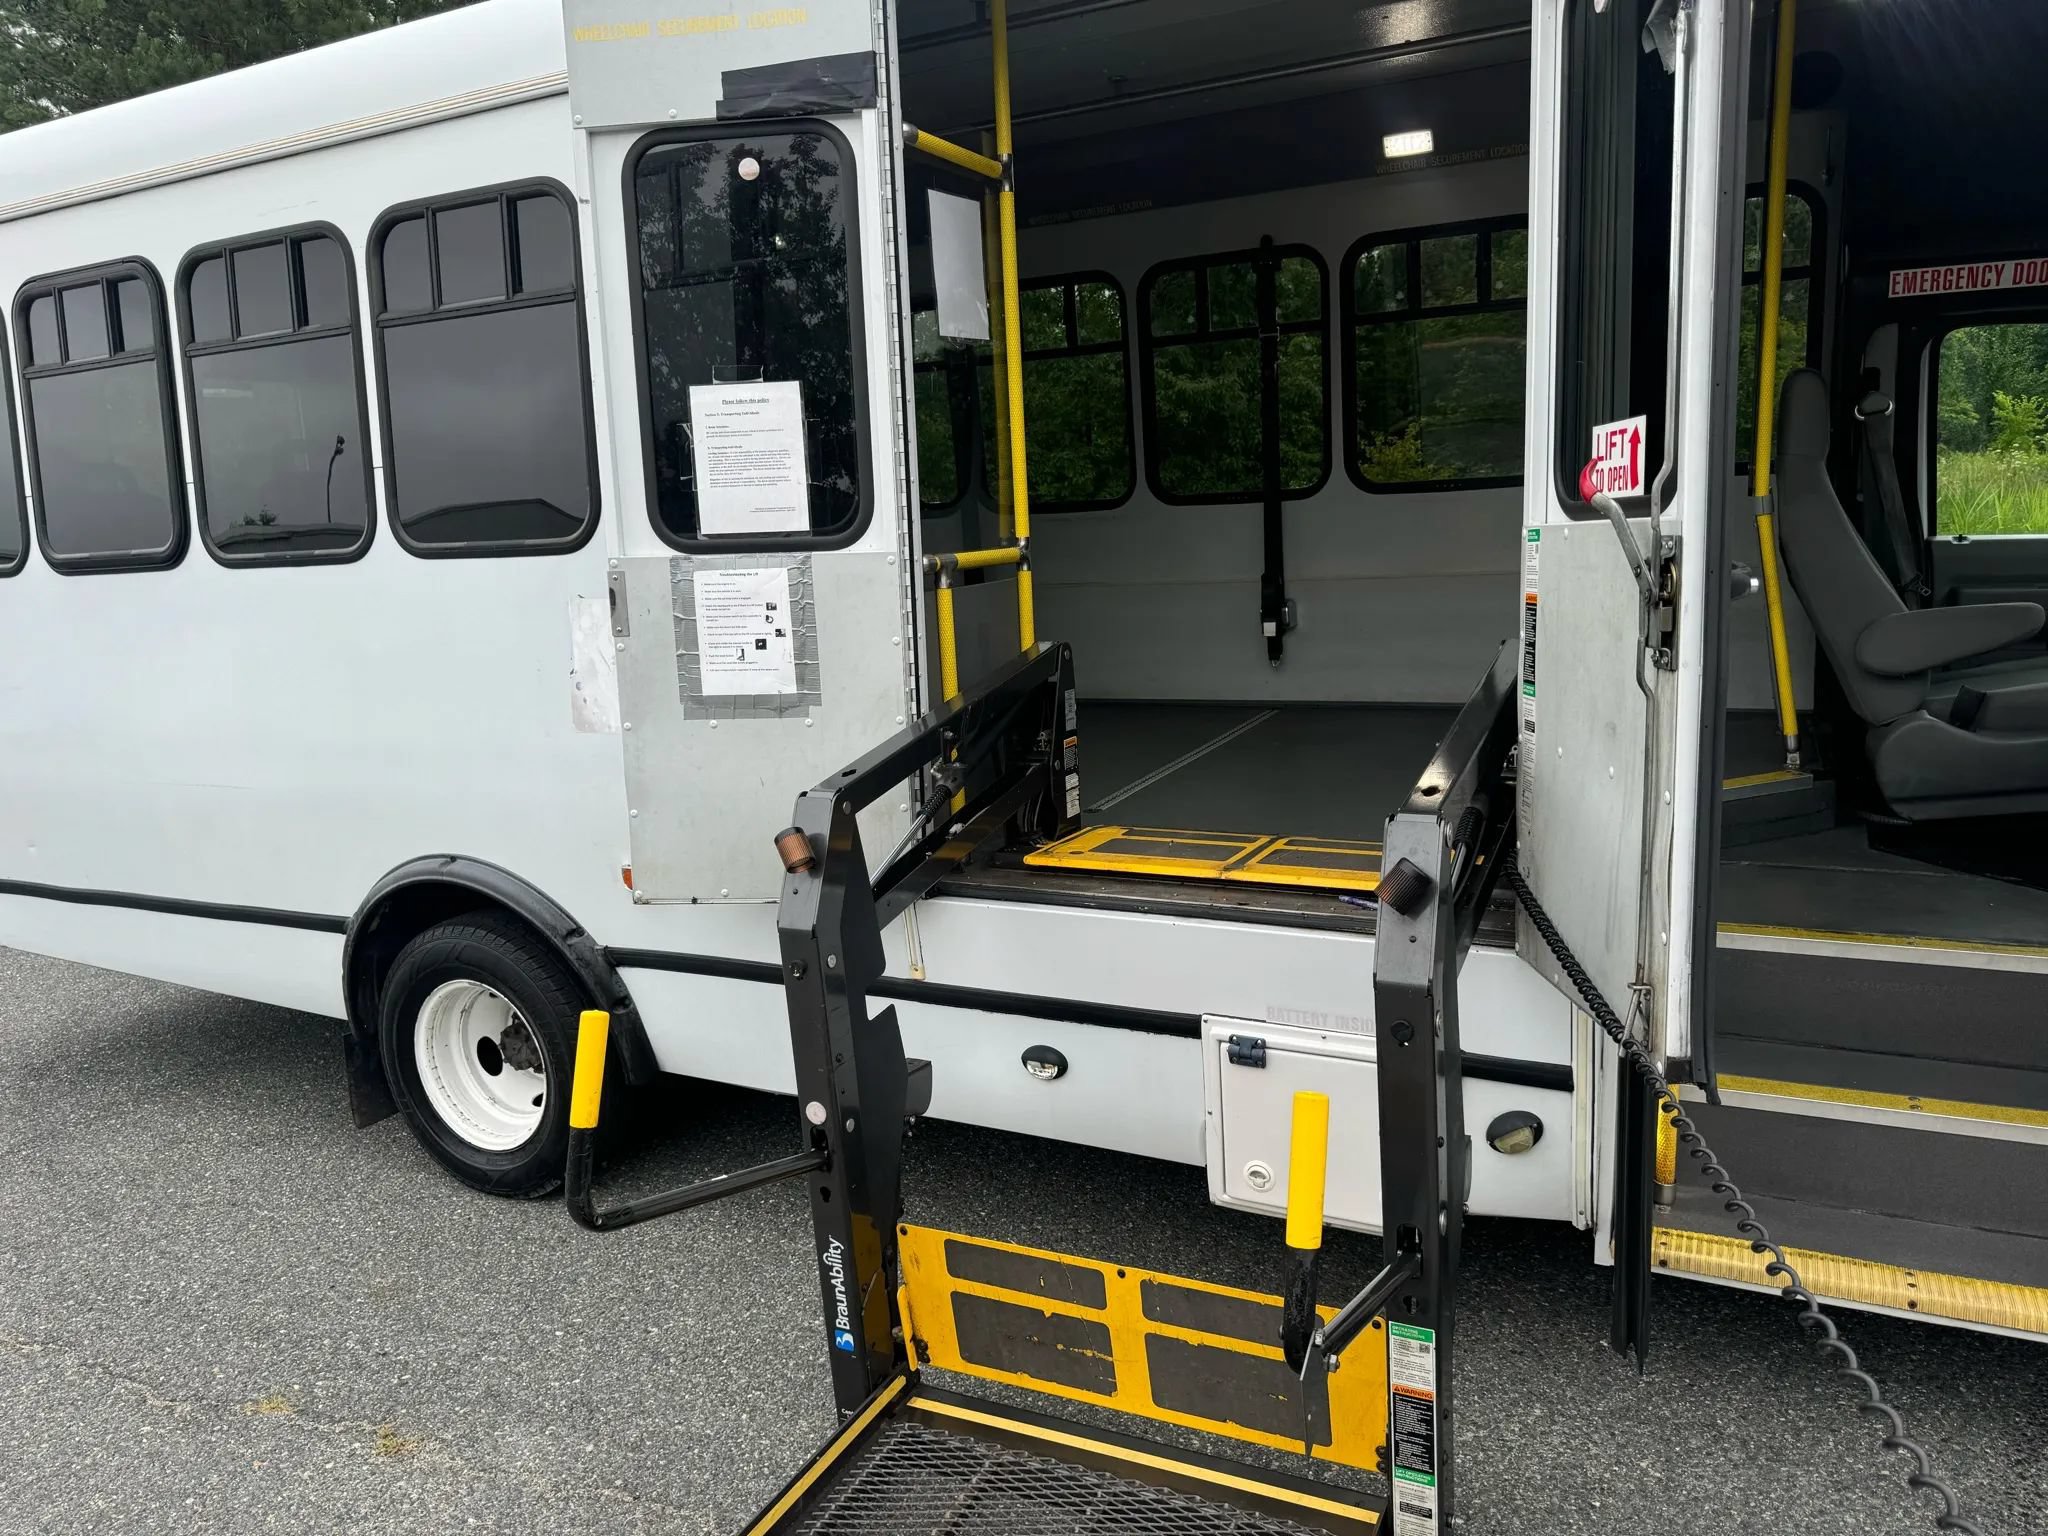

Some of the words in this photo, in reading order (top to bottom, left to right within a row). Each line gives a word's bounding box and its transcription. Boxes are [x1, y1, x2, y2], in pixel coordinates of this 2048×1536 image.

[574, 22, 649, 41] WHEELCHAIR
[656, 15, 738, 36] SECUREMENT
[748, 8, 807, 29] LOCATION
[1377, 158, 1426, 175] WHEELCHAIR
[1432, 149, 1486, 167] SECUREMENT
[1891, 263, 2005, 296] EMERGENCY
[1597, 428, 1628, 462] LIFT
[1595, 468, 1604, 493] TO
[1608, 465, 1629, 493] OPEN
[1267, 1006, 1328, 1027] BATTERY
[823, 1234, 850, 1330] BraunAbility
[1400, 1386, 1433, 1400] WARNING
